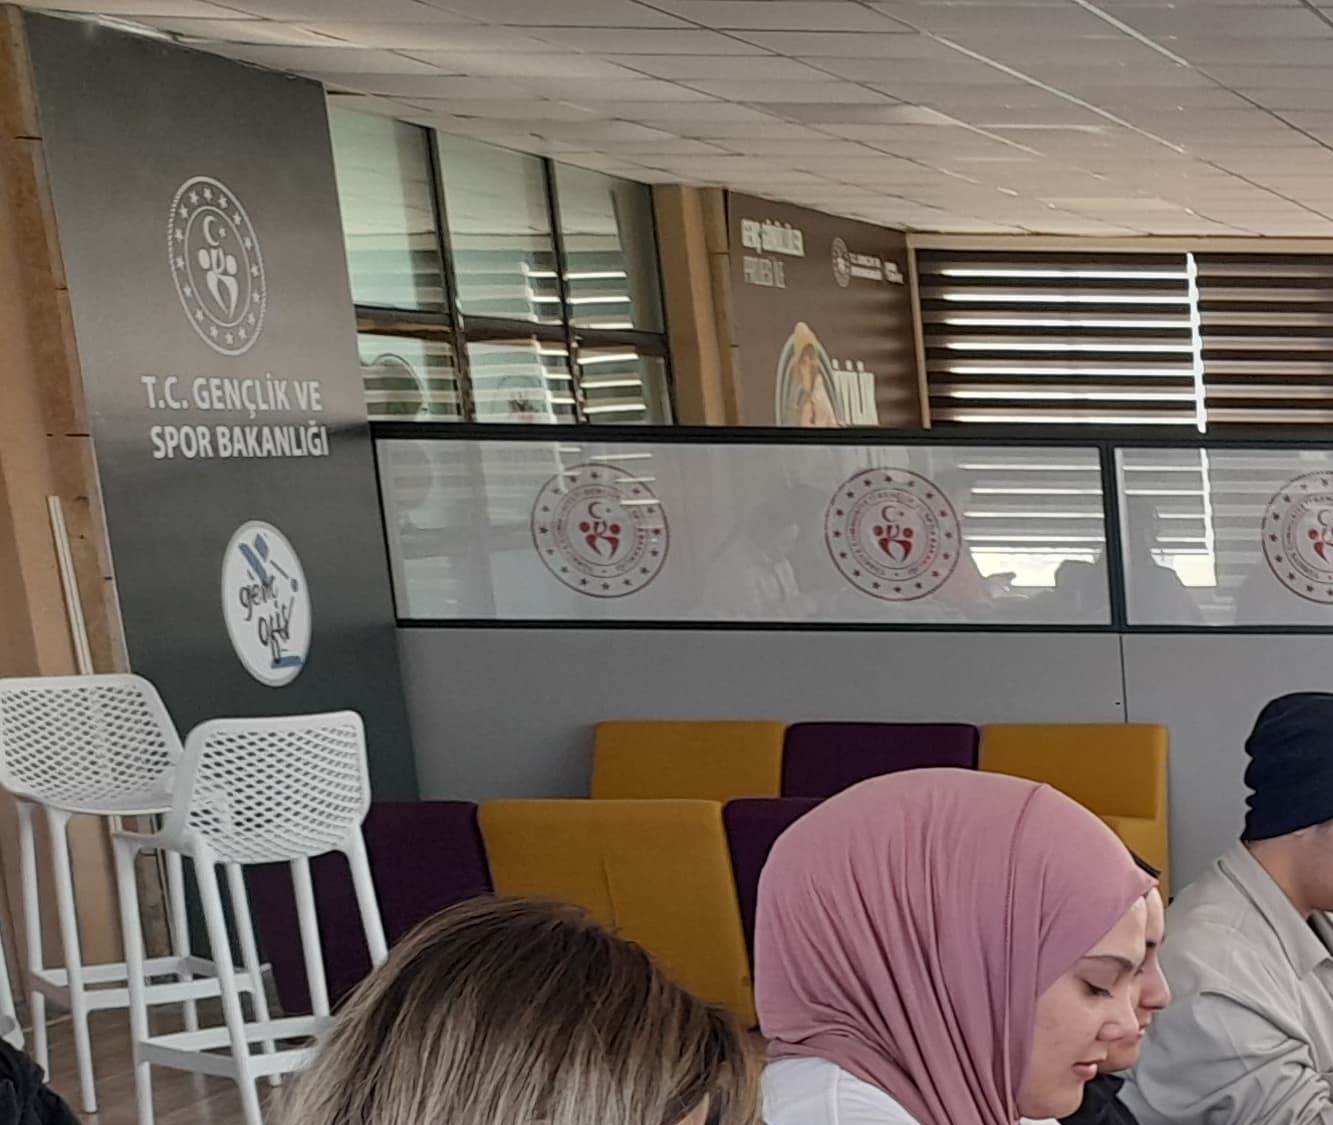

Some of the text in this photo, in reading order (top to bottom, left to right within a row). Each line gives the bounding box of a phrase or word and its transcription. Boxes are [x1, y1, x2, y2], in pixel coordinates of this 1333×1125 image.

[141, 373, 323, 420] T.C. GENÇLİK VE
[150, 420, 329, 459] SPOR BAKANLIĞI
